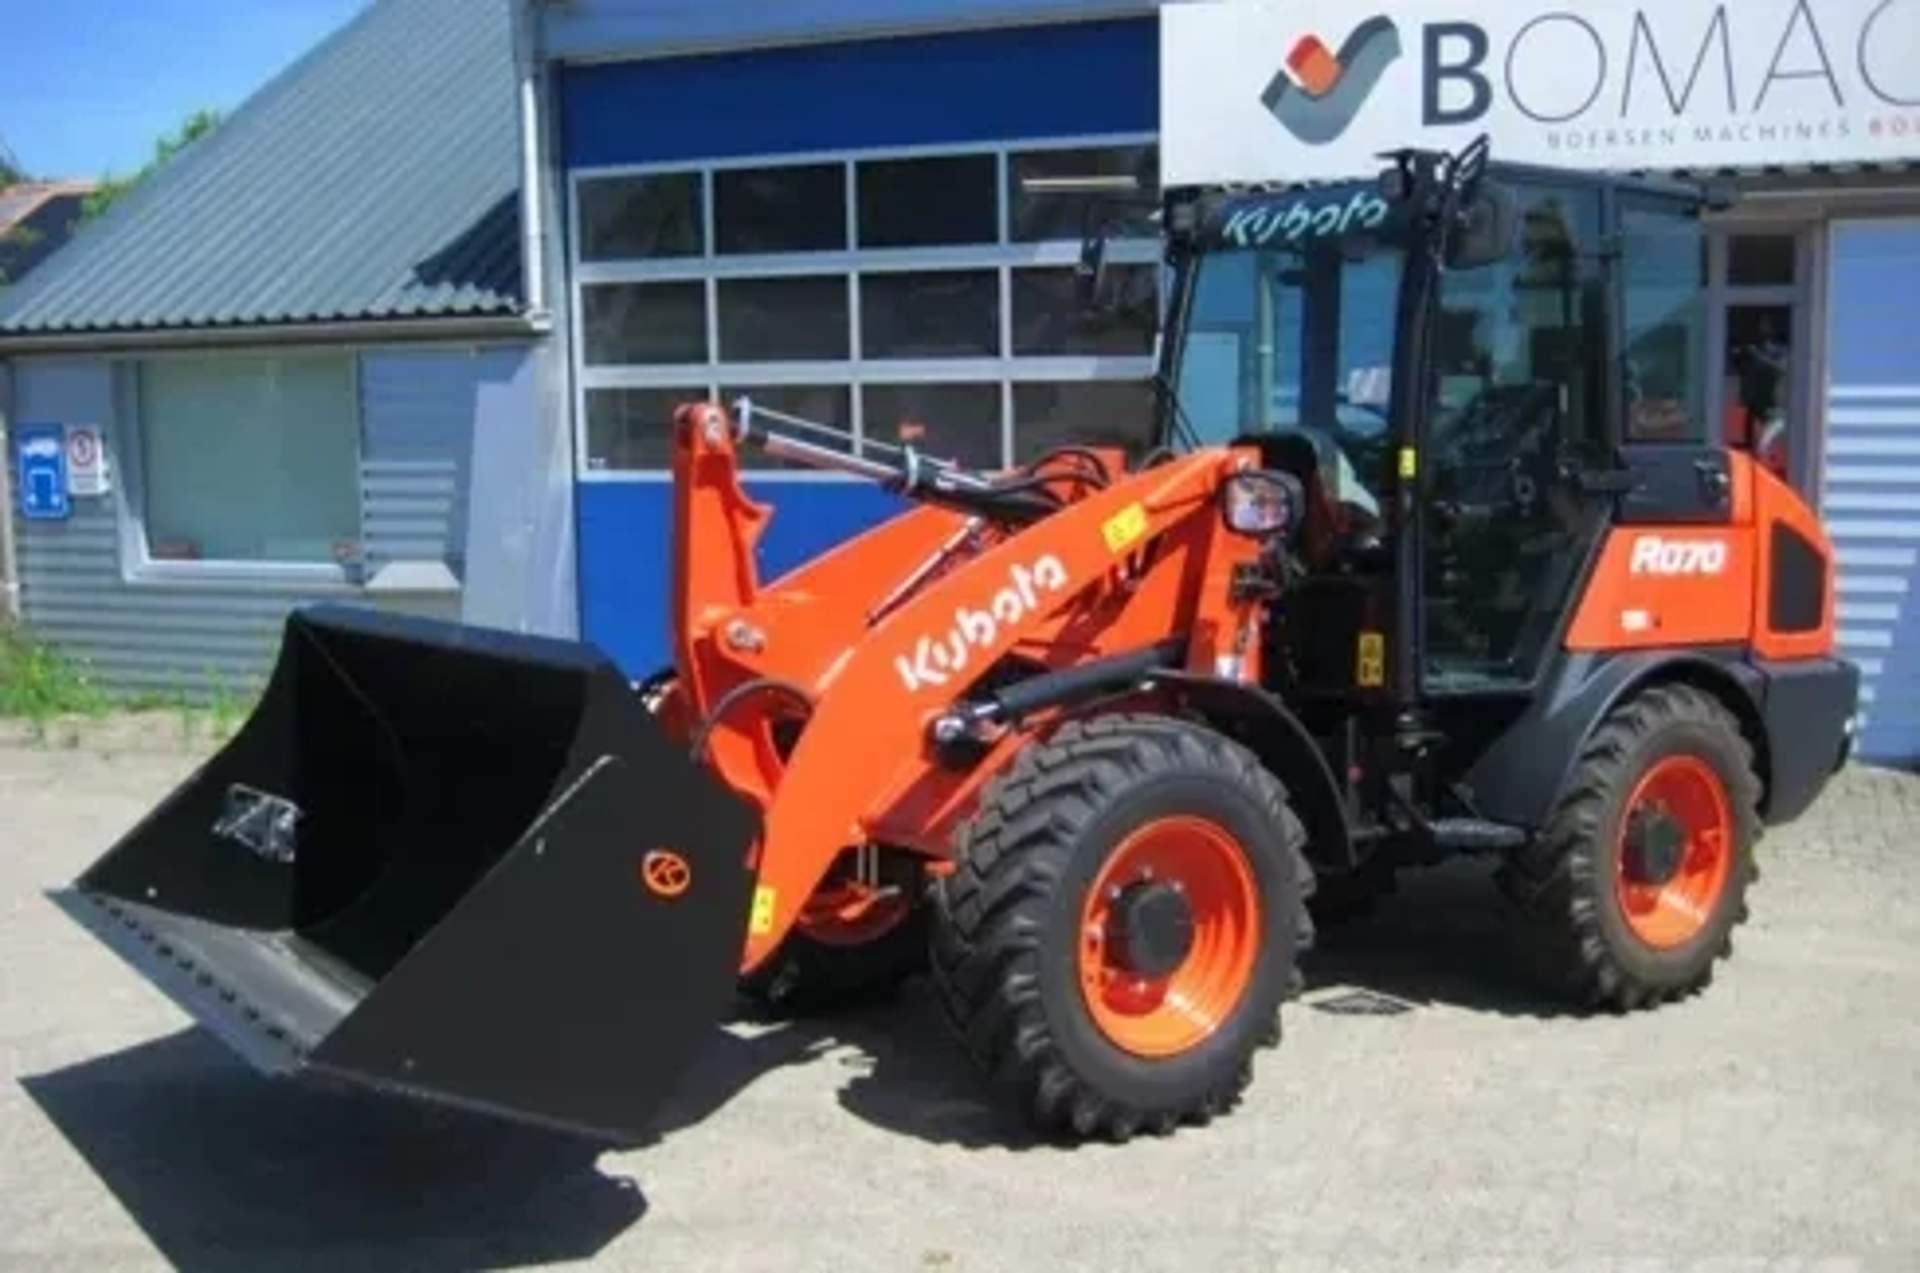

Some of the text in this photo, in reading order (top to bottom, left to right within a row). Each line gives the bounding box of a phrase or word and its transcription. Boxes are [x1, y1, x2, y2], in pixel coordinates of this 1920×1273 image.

[1422, 0, 1920, 126] BOMAC
[1694, 117, 1851, 142] MACHINES
[1222, 191, 1388, 246] Kubota
[1630, 535, 1726, 574] R070
[895, 555, 1068, 692] Kubota
